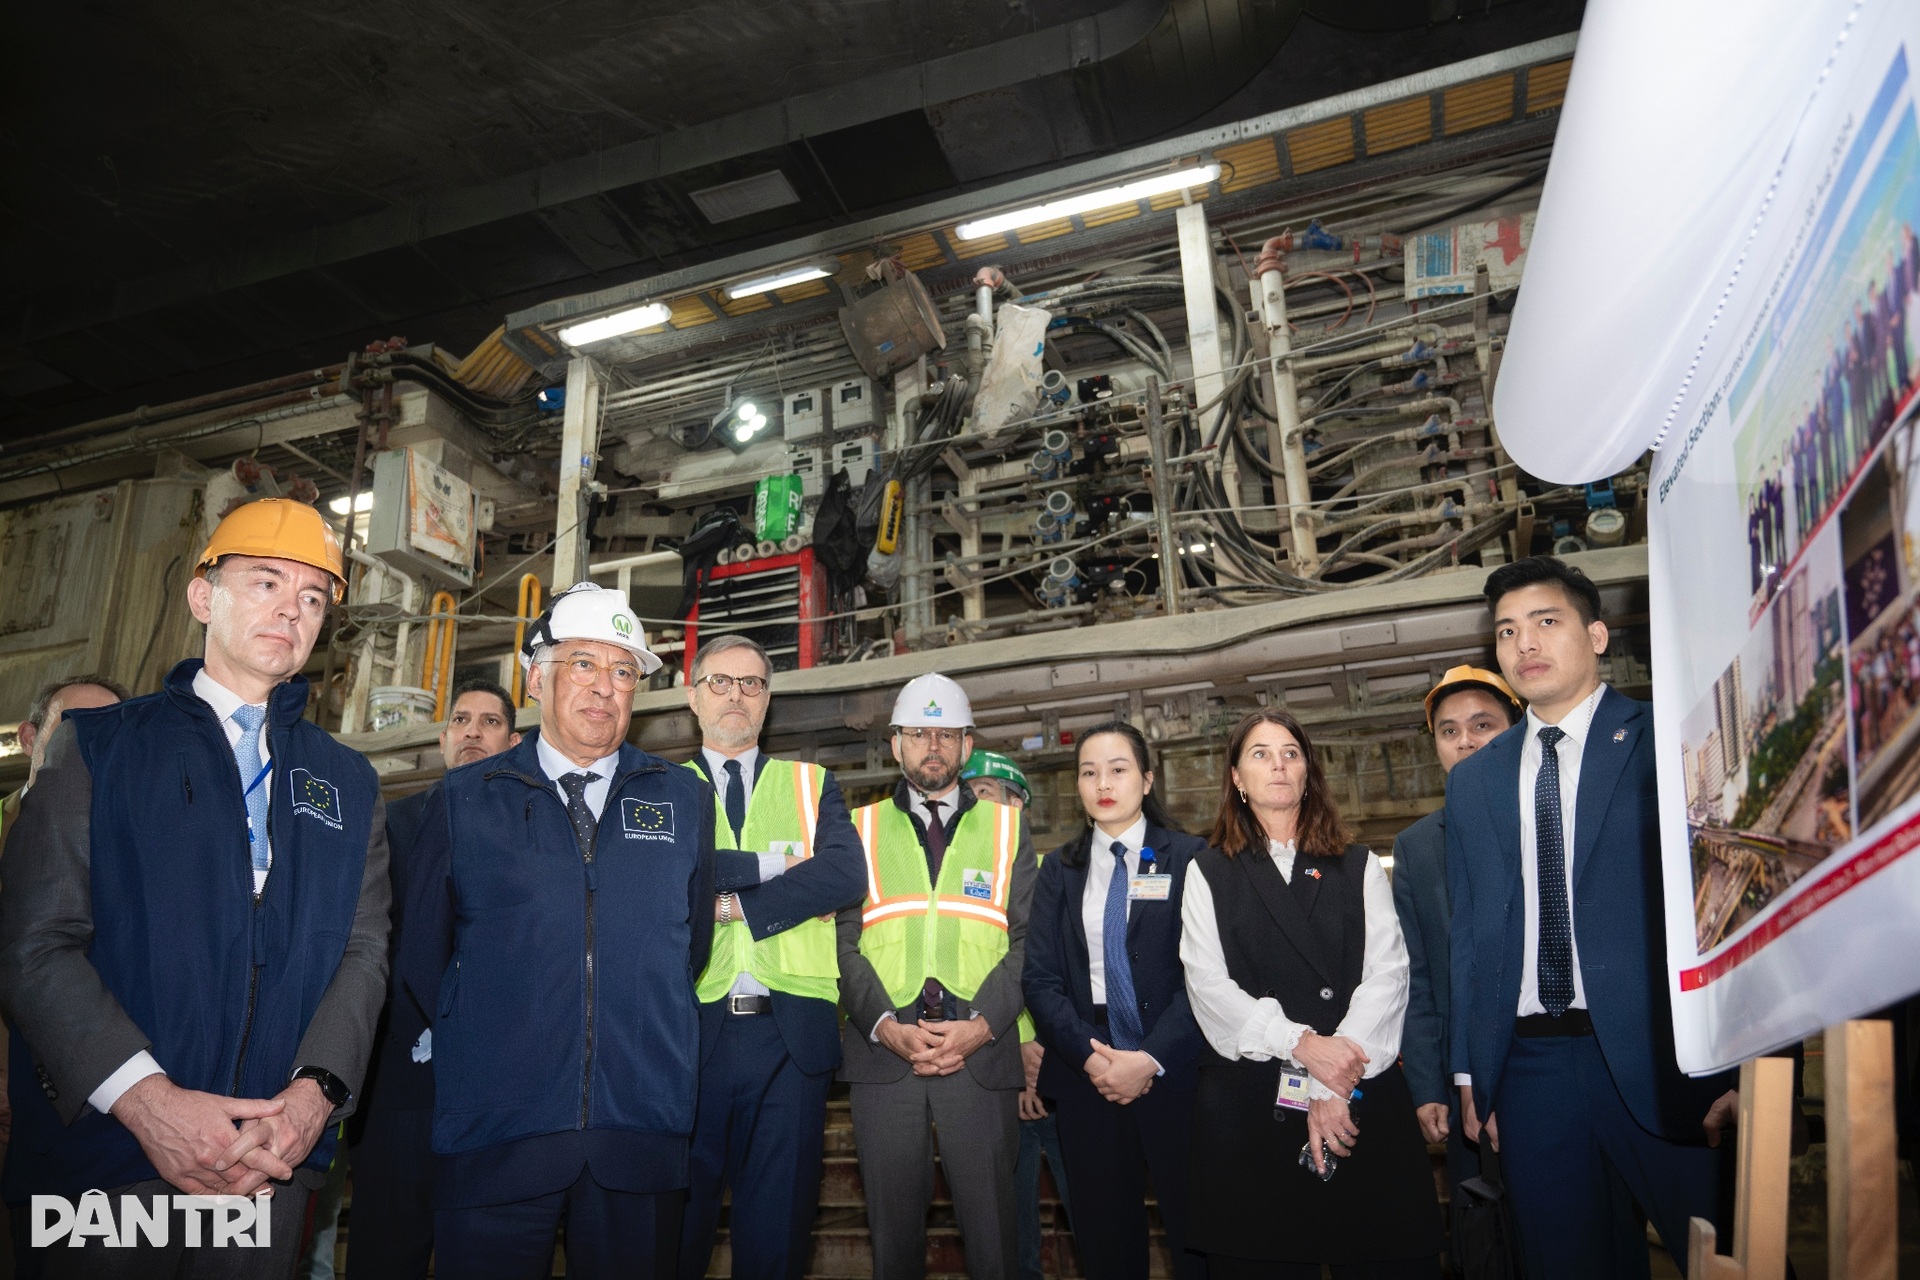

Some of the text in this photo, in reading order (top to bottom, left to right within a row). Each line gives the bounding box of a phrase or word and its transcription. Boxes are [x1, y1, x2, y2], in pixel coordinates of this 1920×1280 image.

[1659, 440, 1689, 504] Elevated
[1688, 388, 1723, 450] Section:
[624, 832, 658, 840] EUROPEAN
